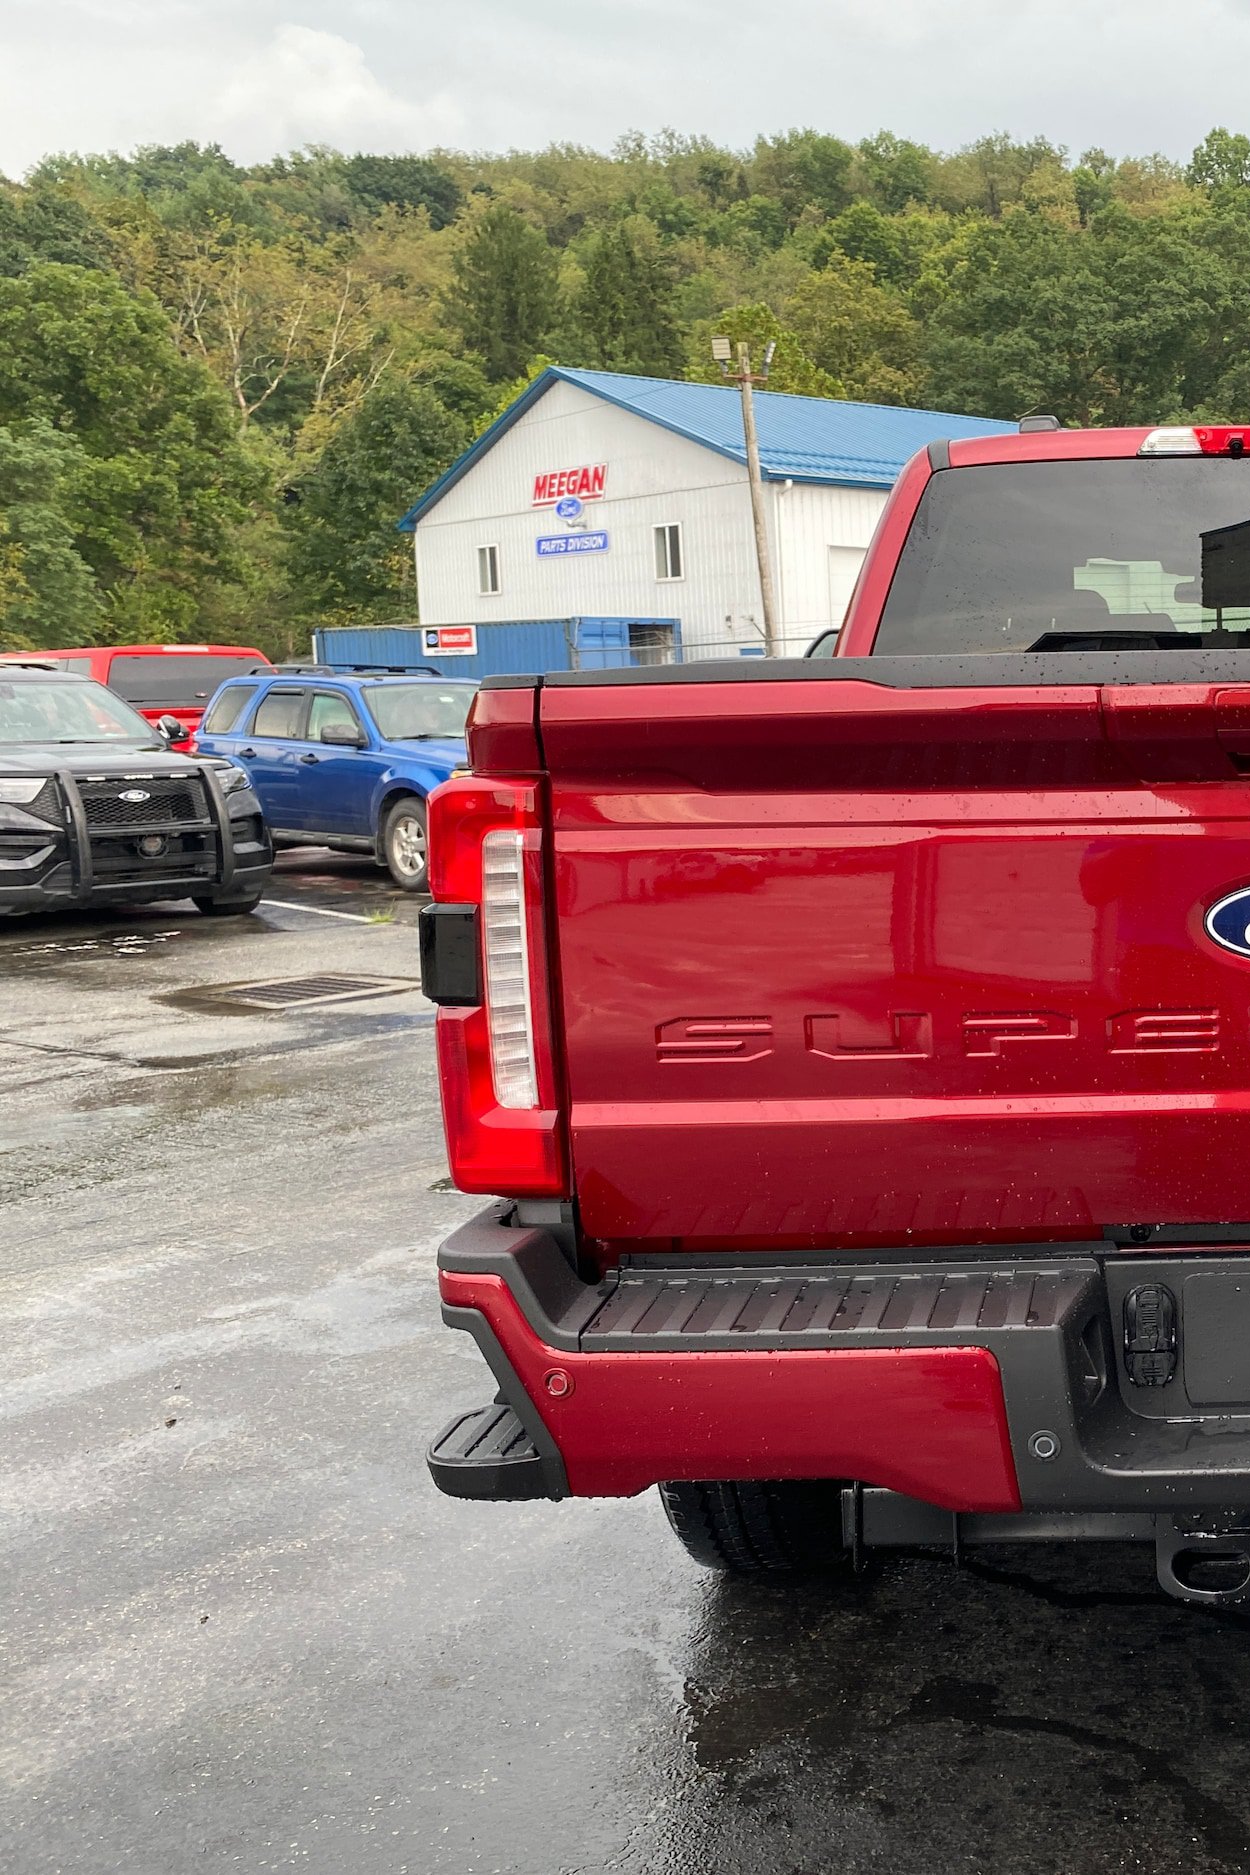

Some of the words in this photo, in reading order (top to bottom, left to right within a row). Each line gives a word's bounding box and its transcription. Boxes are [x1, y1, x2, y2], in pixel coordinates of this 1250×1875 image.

[533, 465, 606, 500] MEEGAN
[540, 539, 566, 554] PARTS
[567, 534, 605, 552] DIVISION
